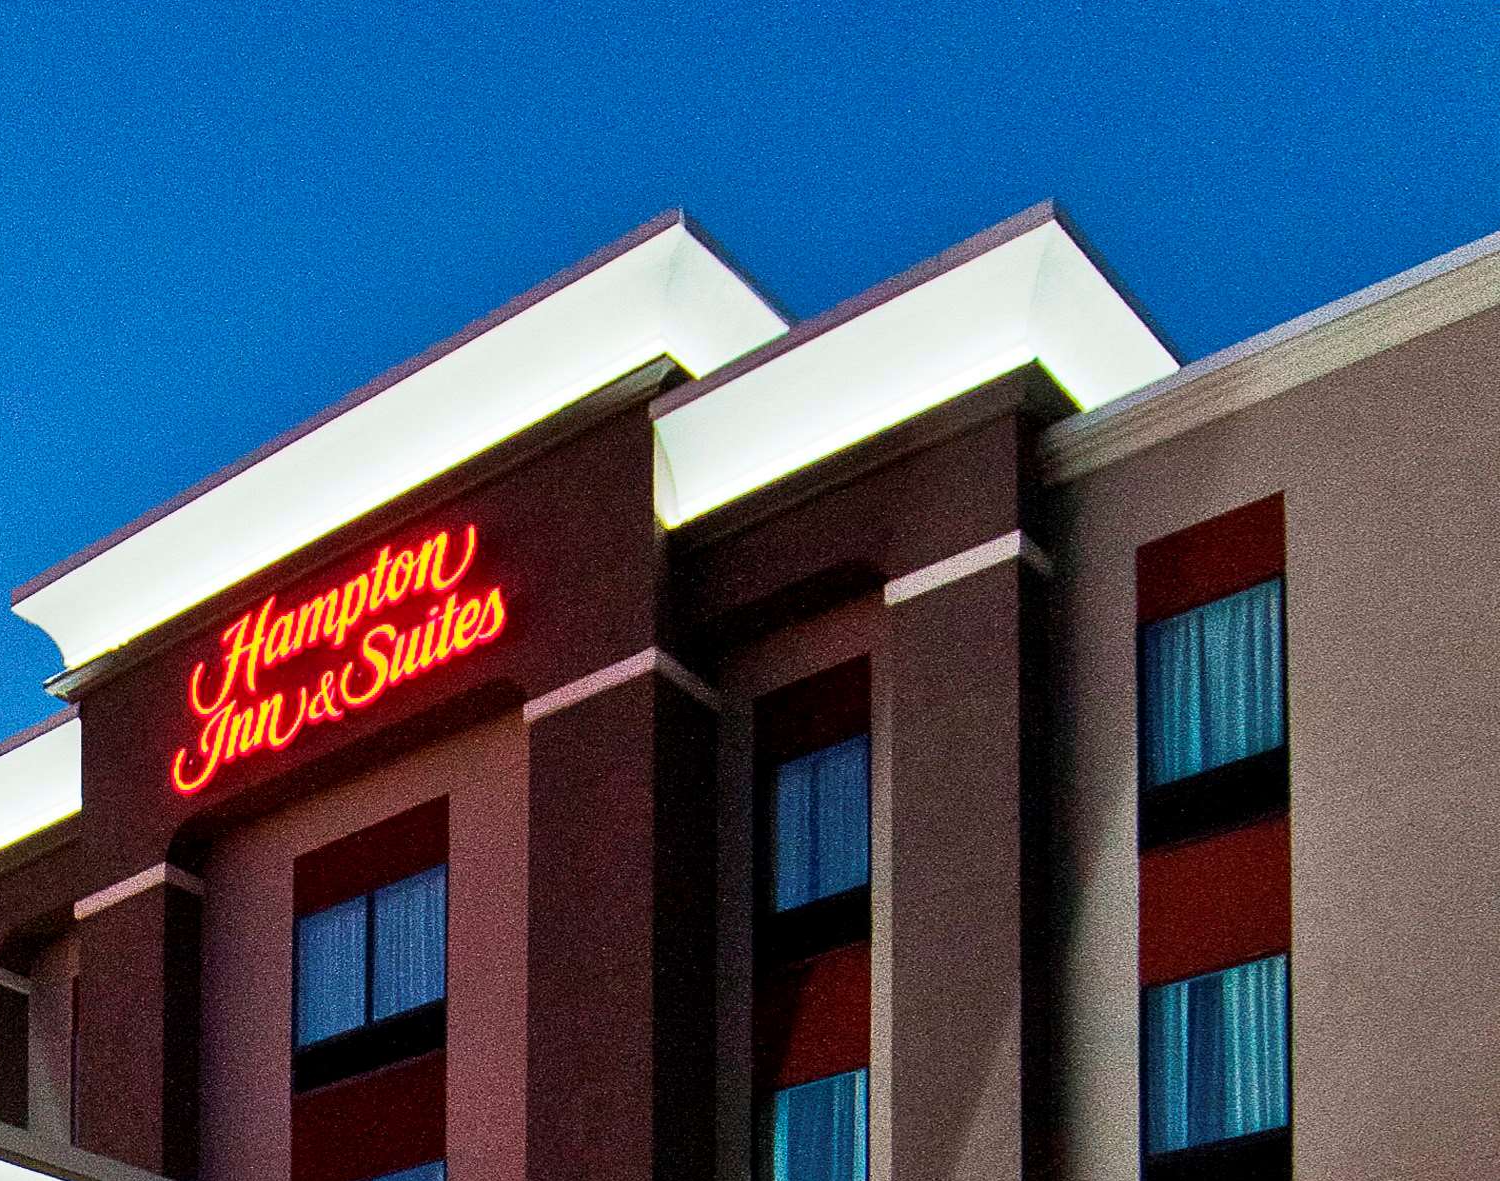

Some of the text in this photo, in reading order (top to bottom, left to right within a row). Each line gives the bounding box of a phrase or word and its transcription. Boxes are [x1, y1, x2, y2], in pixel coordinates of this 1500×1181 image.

[172, 587, 506, 792] Inn & Suites
[190, 525, 476, 714] Hampton
